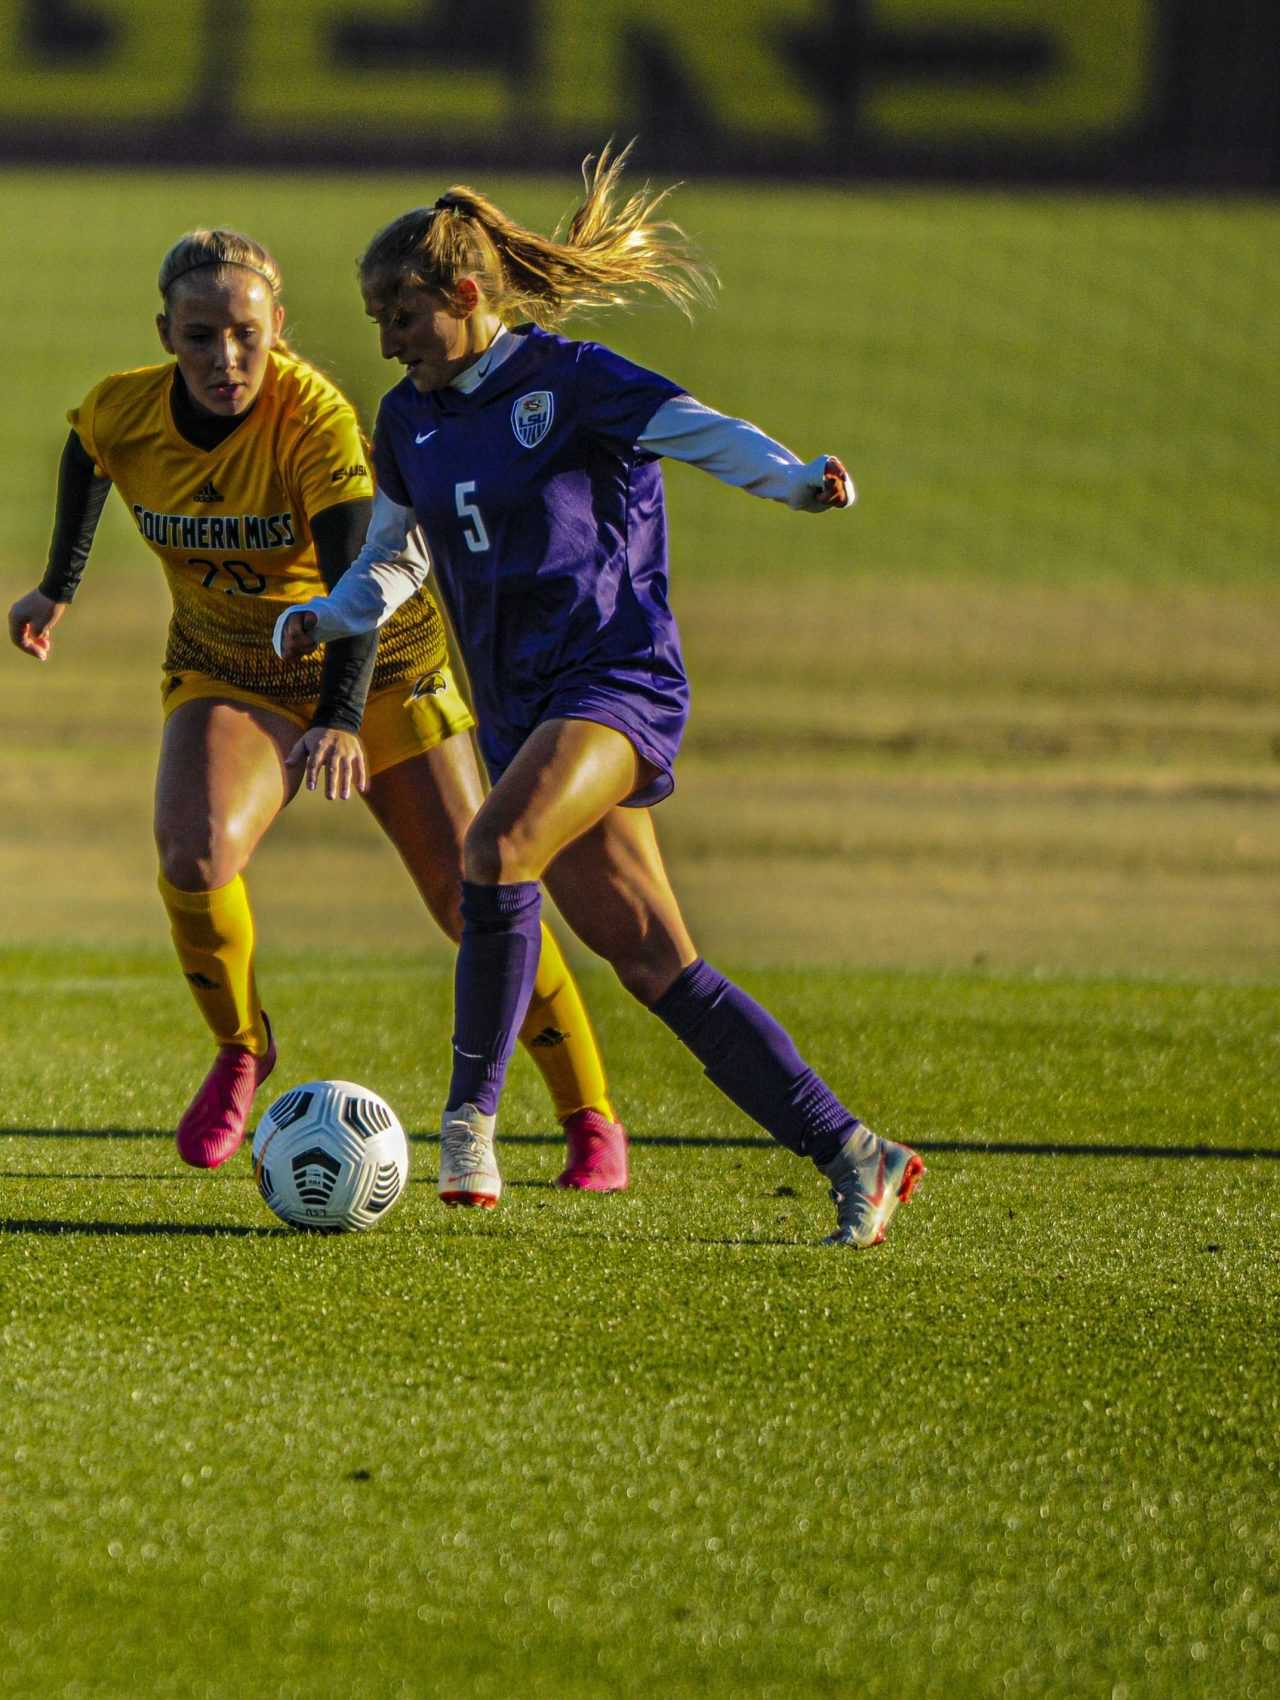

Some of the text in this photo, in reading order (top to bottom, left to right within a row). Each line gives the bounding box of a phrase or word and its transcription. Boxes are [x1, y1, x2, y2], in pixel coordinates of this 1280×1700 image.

[518, 412, 547, 428] LSU
[133, 504, 296, 551] SOUTHERN MISS
[455, 480, 490, 552] 5
